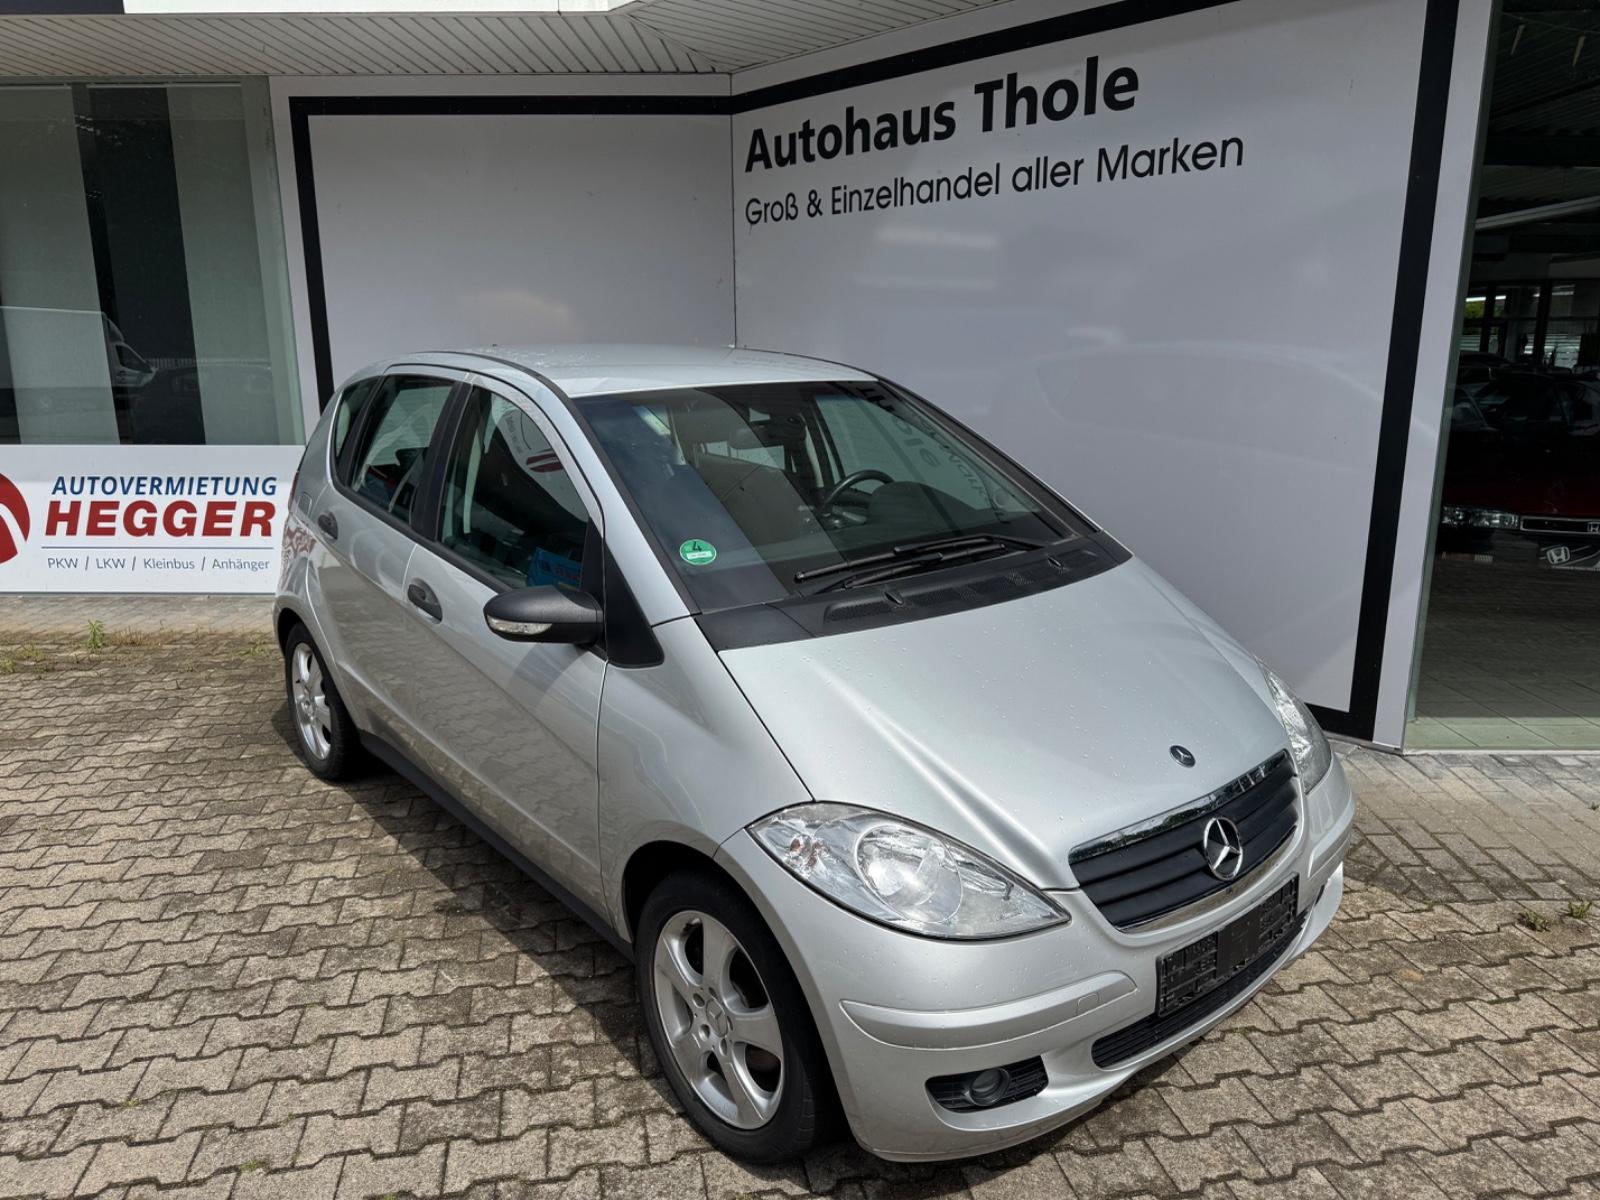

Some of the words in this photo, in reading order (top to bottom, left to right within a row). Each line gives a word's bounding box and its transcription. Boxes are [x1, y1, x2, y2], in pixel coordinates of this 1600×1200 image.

[744, 102, 957, 173] Autohaus
[974, 55, 1140, 133] Thole
[745, 192, 799, 226] Groß
[806, 189, 823, 218] &
[831, 163, 1001, 215] Einzelhandel
[1011, 156, 1085, 193] aller
[1096, 137, 1244, 183] Marken
[51, 475, 278, 496] AUTOVERMIETUNG
[45, 500, 276, 538] HEGGER
[692, 540, 703, 552] 4
[47, 557, 79, 569] PKW
[95, 557, 126, 569] LKW
[143, 557, 196, 570] Kleinbus
[211, 558, 271, 572] Anhänger
